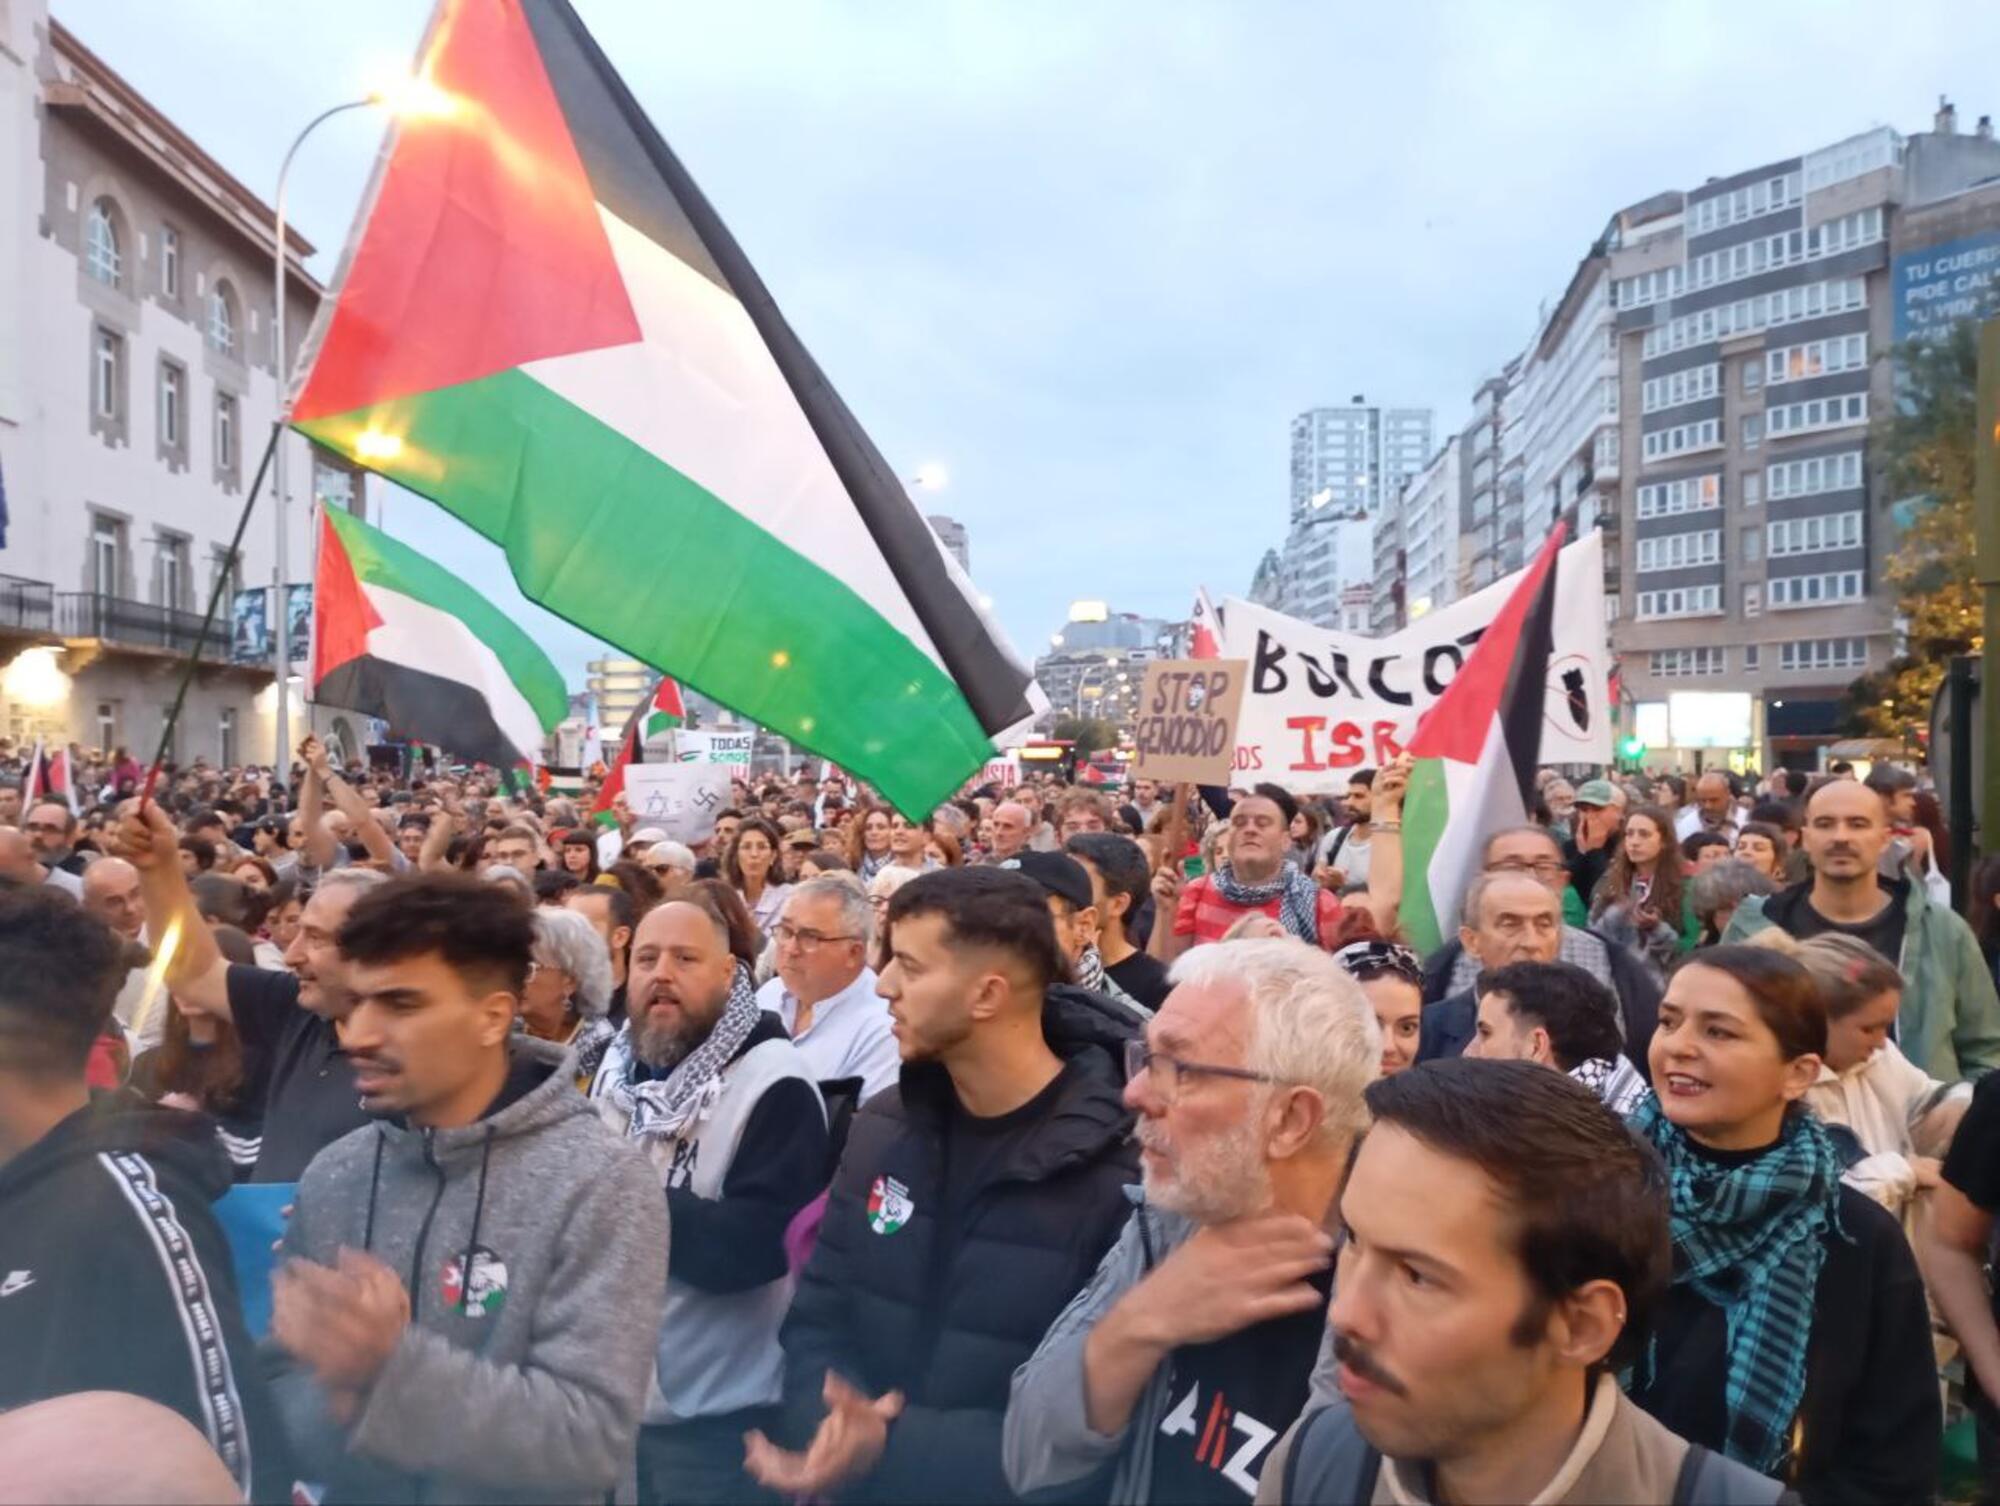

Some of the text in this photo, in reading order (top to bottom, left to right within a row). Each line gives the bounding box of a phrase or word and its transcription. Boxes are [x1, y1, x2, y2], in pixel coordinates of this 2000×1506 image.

[1906, 262, 1930, 282] TU
[1906, 270, 1997, 304] PIDE CAL
[1152, 672, 1230, 717] STOP
[710, 737, 751, 751] TODAS
[1286, 716, 1403, 771] ISR
